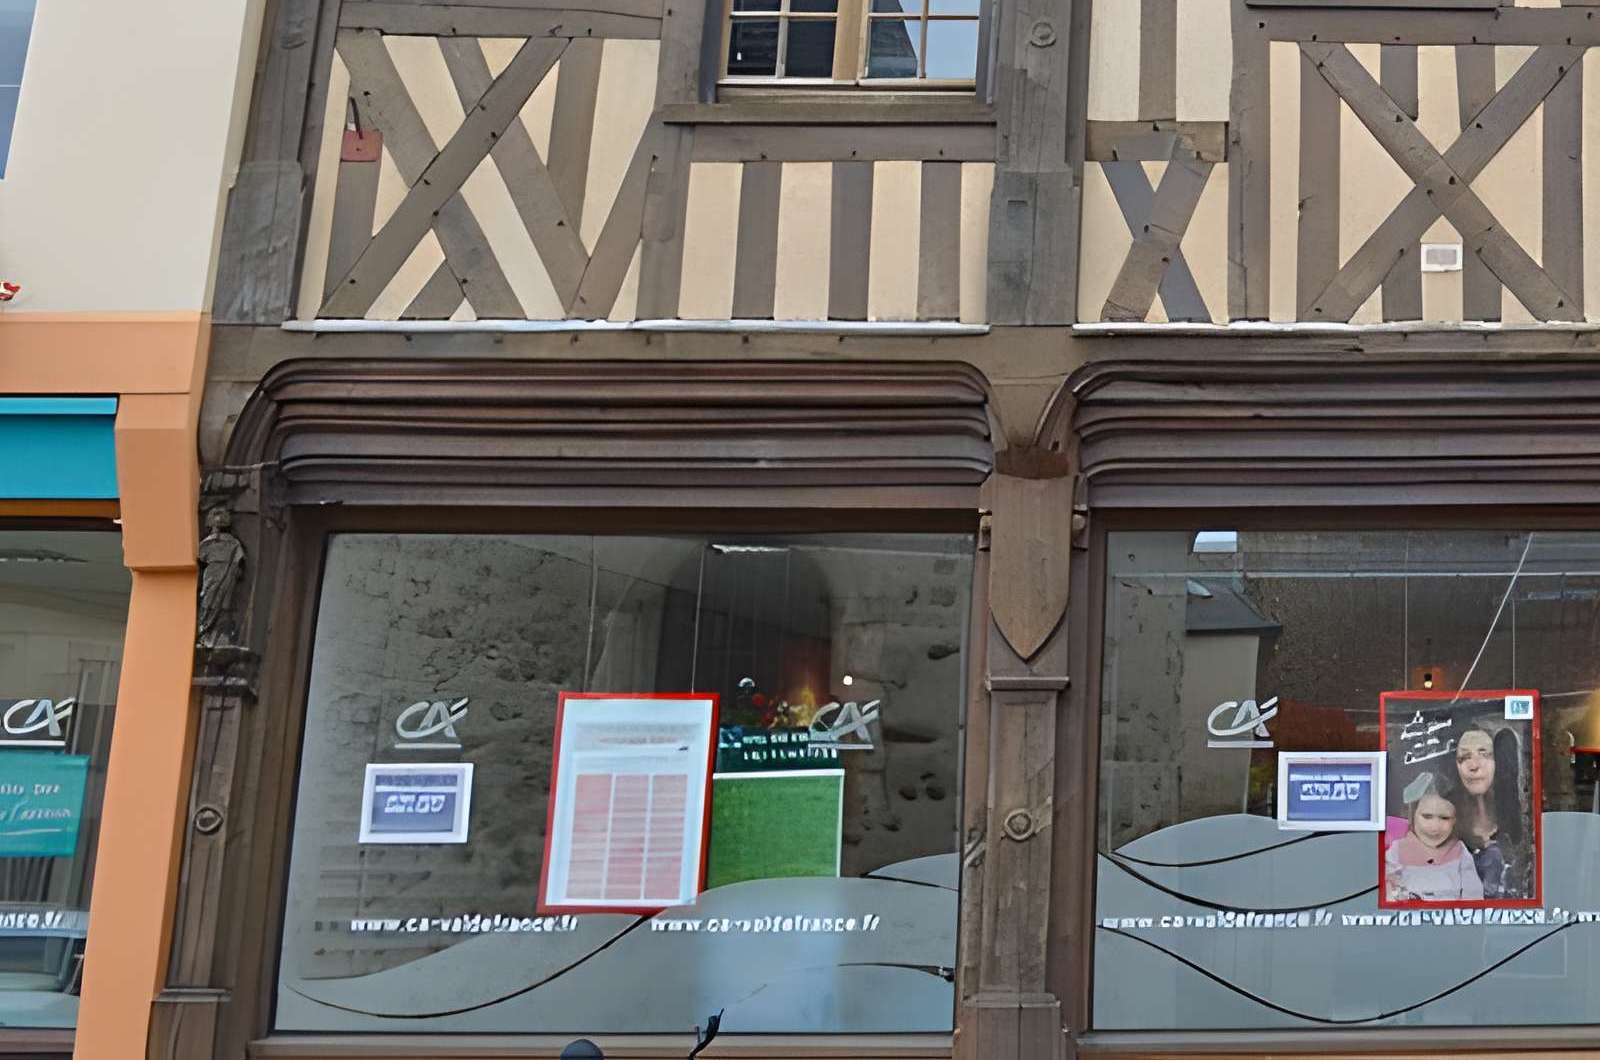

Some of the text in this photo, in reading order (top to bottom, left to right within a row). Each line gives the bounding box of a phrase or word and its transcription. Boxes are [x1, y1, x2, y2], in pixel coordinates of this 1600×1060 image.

[3, 697, 75, 737] CA
[395, 697, 469, 739] CA
[809, 699, 881, 744] CA
[1207, 696, 1278, 738] CA
